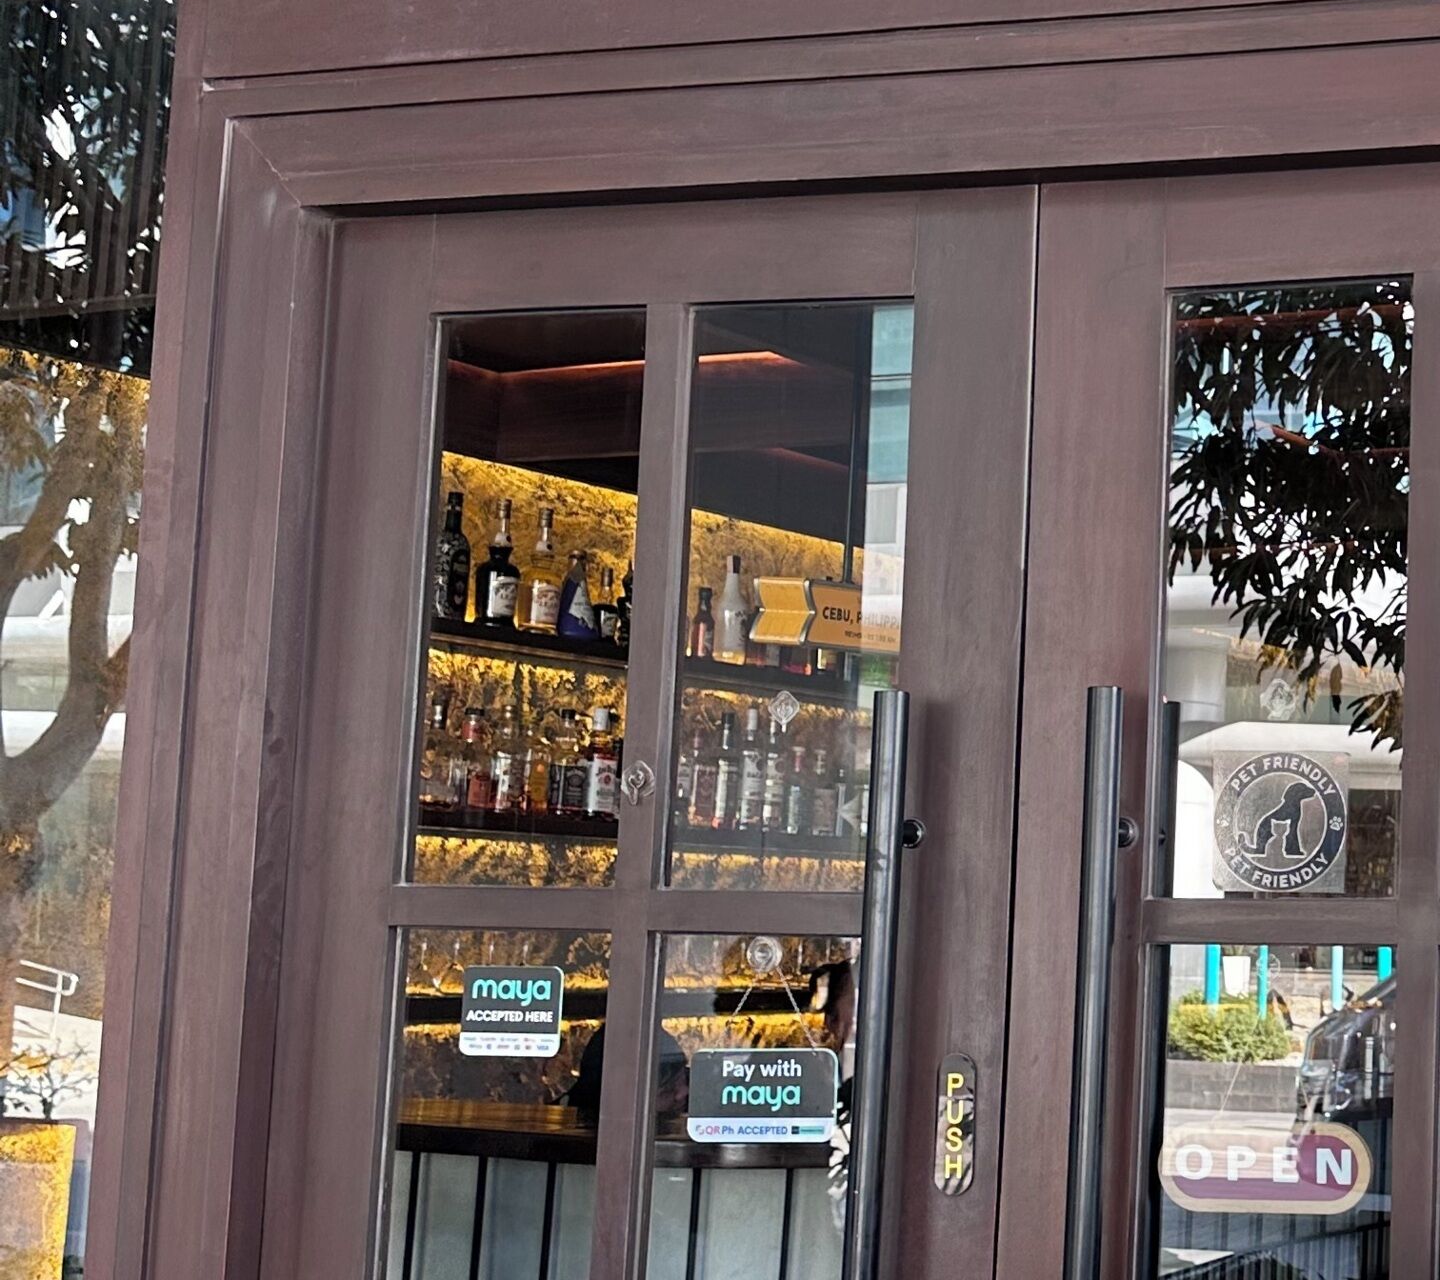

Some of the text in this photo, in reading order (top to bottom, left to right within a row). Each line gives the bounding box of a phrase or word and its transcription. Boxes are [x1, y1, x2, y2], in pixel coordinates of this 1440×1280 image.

[1230, 756, 1336, 795] PET FRIENDLY
[1224, 848, 1329, 888] PET FRIENDLY
[472, 977, 551, 1006] maya
[466, 1010, 553, 1024] ACCEPTED HERE
[722, 1060, 802, 1081] Pay with
[722, 1084, 801, 1112] maya
[737, 1125, 788, 1135] ACCEPTED
[944, 1072, 965, 1180] PUSH
[1175, 1144, 1352, 1186] OPEN
